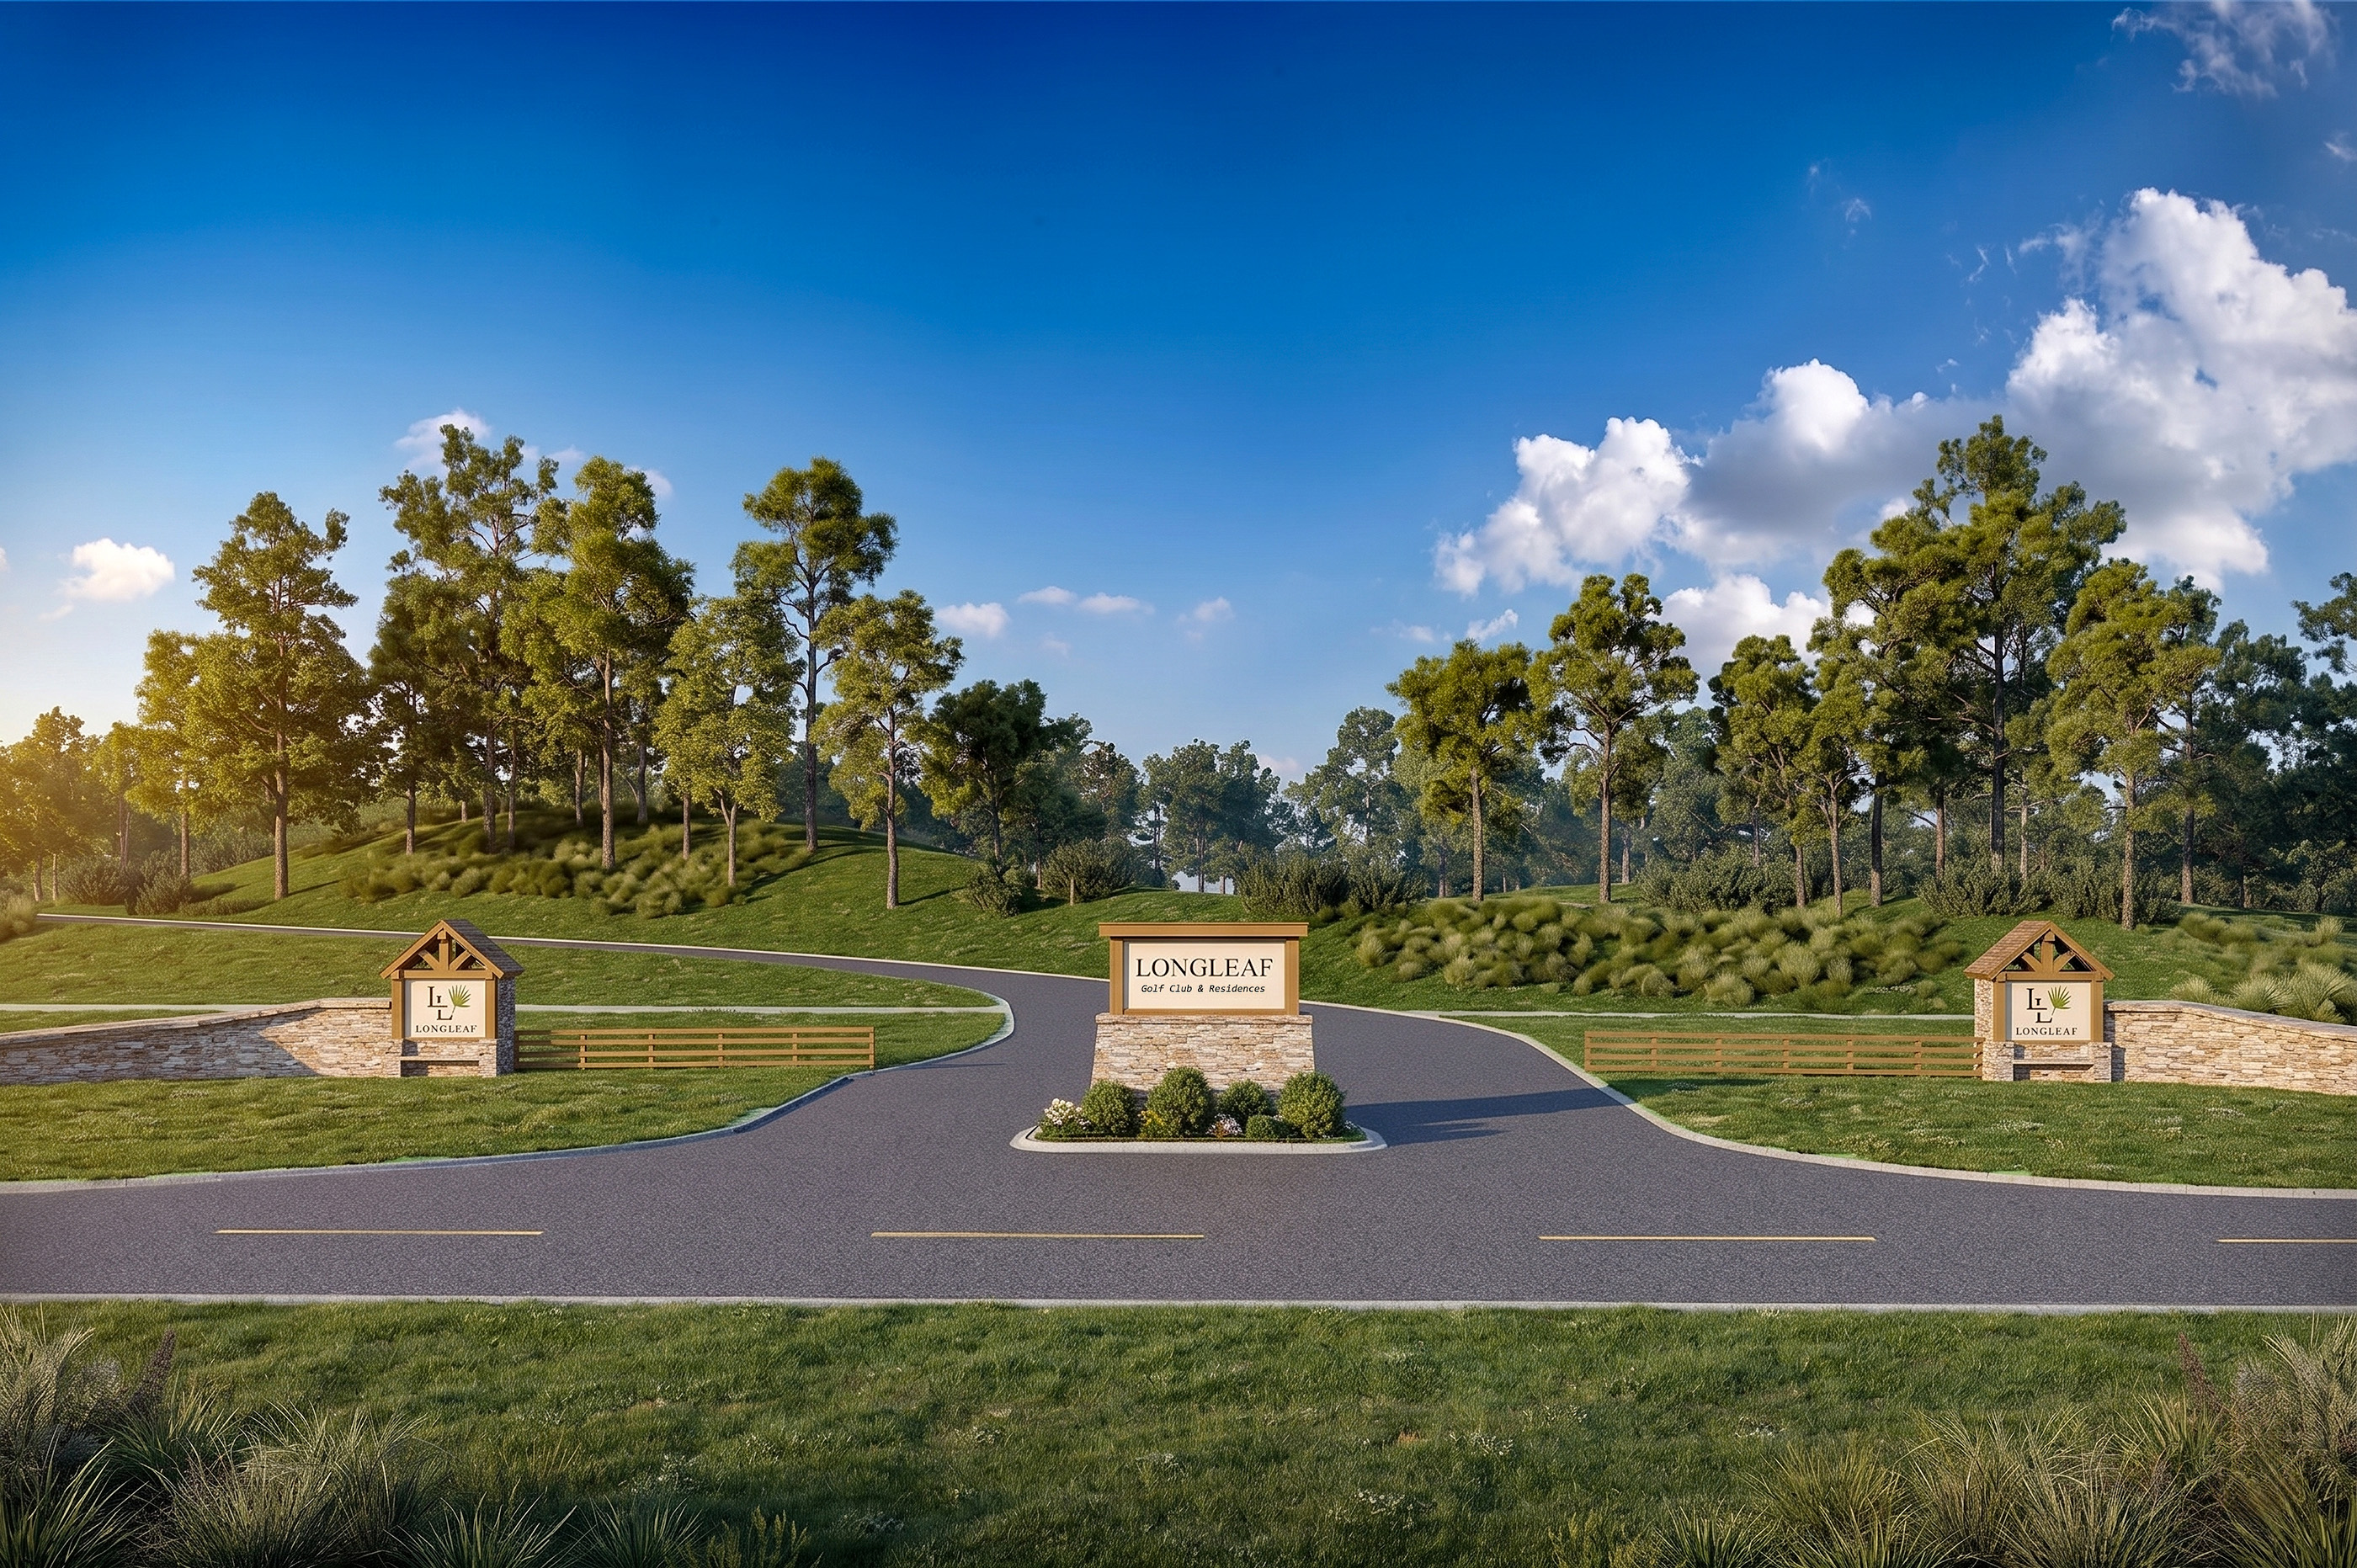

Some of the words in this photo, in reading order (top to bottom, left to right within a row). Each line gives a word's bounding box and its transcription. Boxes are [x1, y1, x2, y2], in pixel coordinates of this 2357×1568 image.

[1136, 958, 1274, 977] LONGLEAF
[1141, 984, 1165, 993] Golf
[1169, 984, 1193, 993] Club
[1198, 984, 1205, 993] &
[1209, 984, 1265, 993] Residences
[416, 1024, 477, 1034] LONGLEAF
[2015, 1027, 2078, 1036] LONGLEAF
